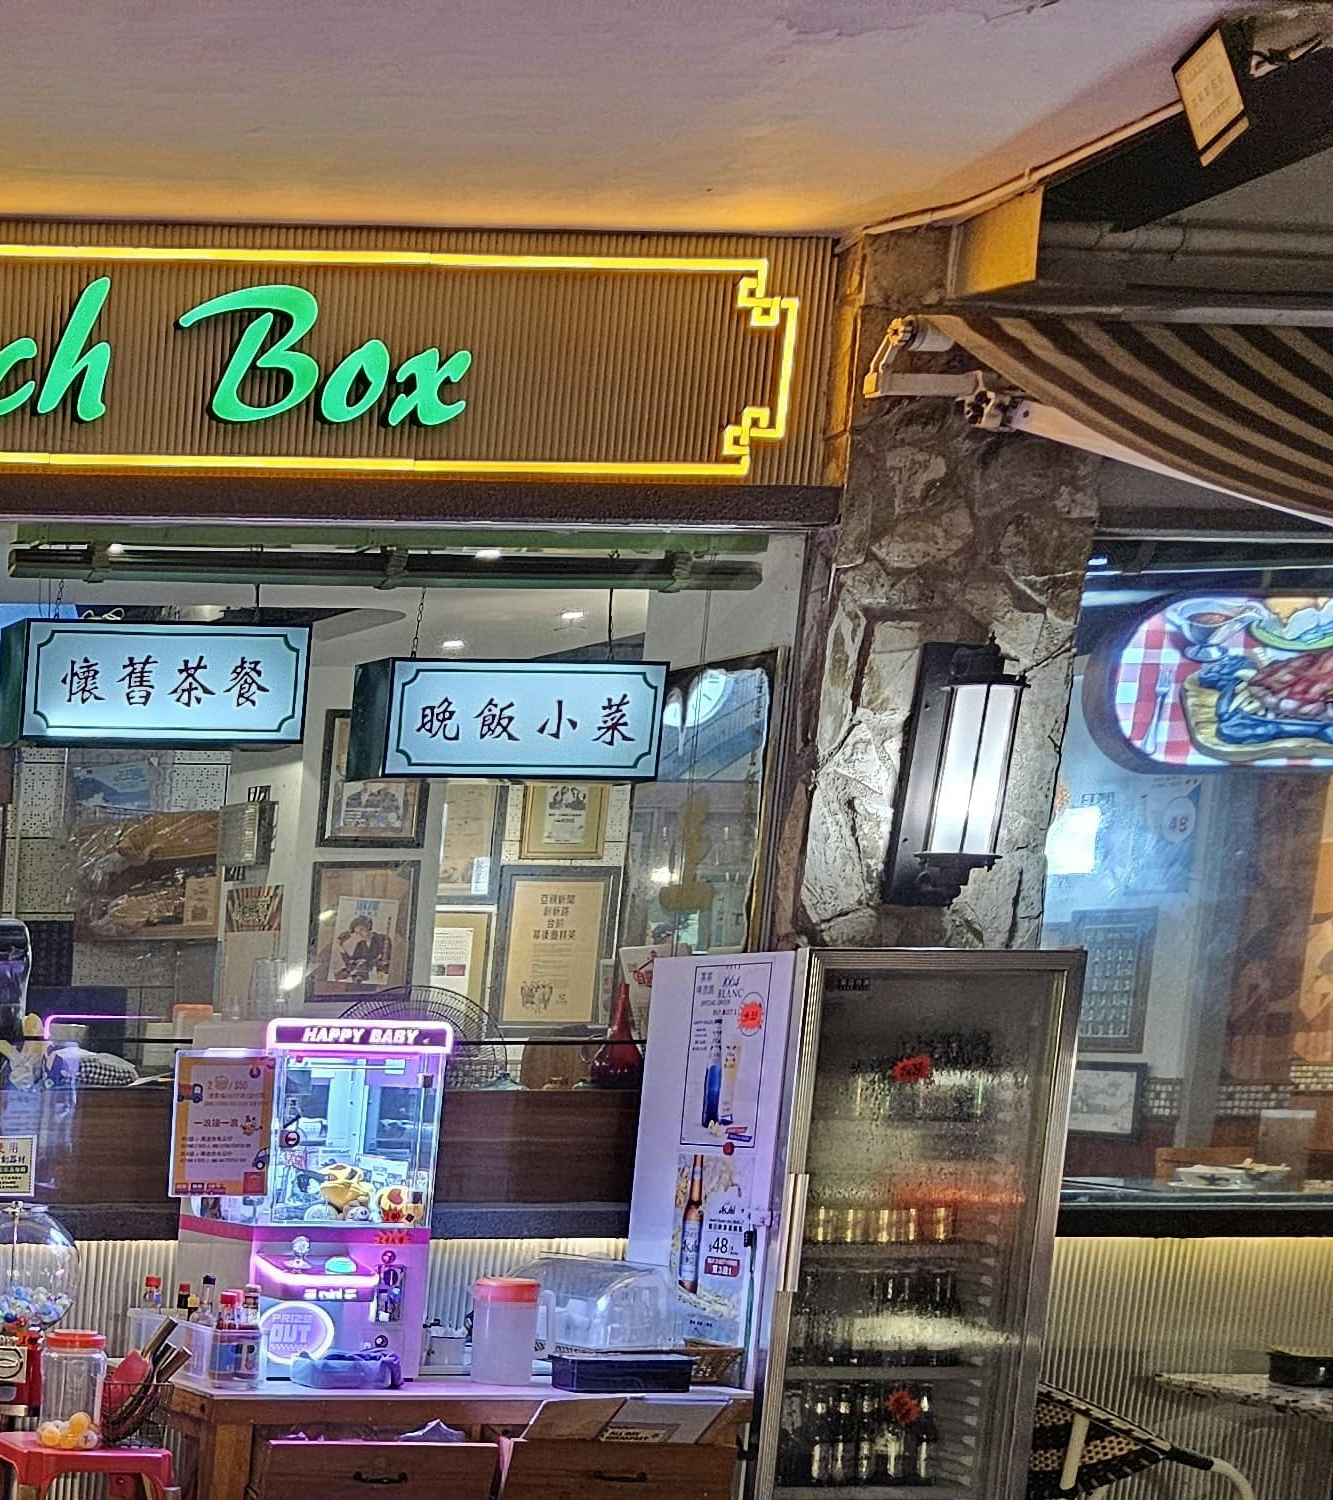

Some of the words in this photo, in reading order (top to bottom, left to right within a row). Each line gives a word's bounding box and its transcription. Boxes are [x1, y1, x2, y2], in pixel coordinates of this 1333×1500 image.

[178, 282, 472, 429] Box
[61, 655, 270, 708] 懷舊茶餐
[415, 692, 637, 752] 晚飯小菜
[301, 1027, 365, 1043] HAPPY
[368, 1028, 420, 1045] BABY
[269, 1324, 312, 1344] OUT
[271, 1313, 313, 1323] PRIZE
